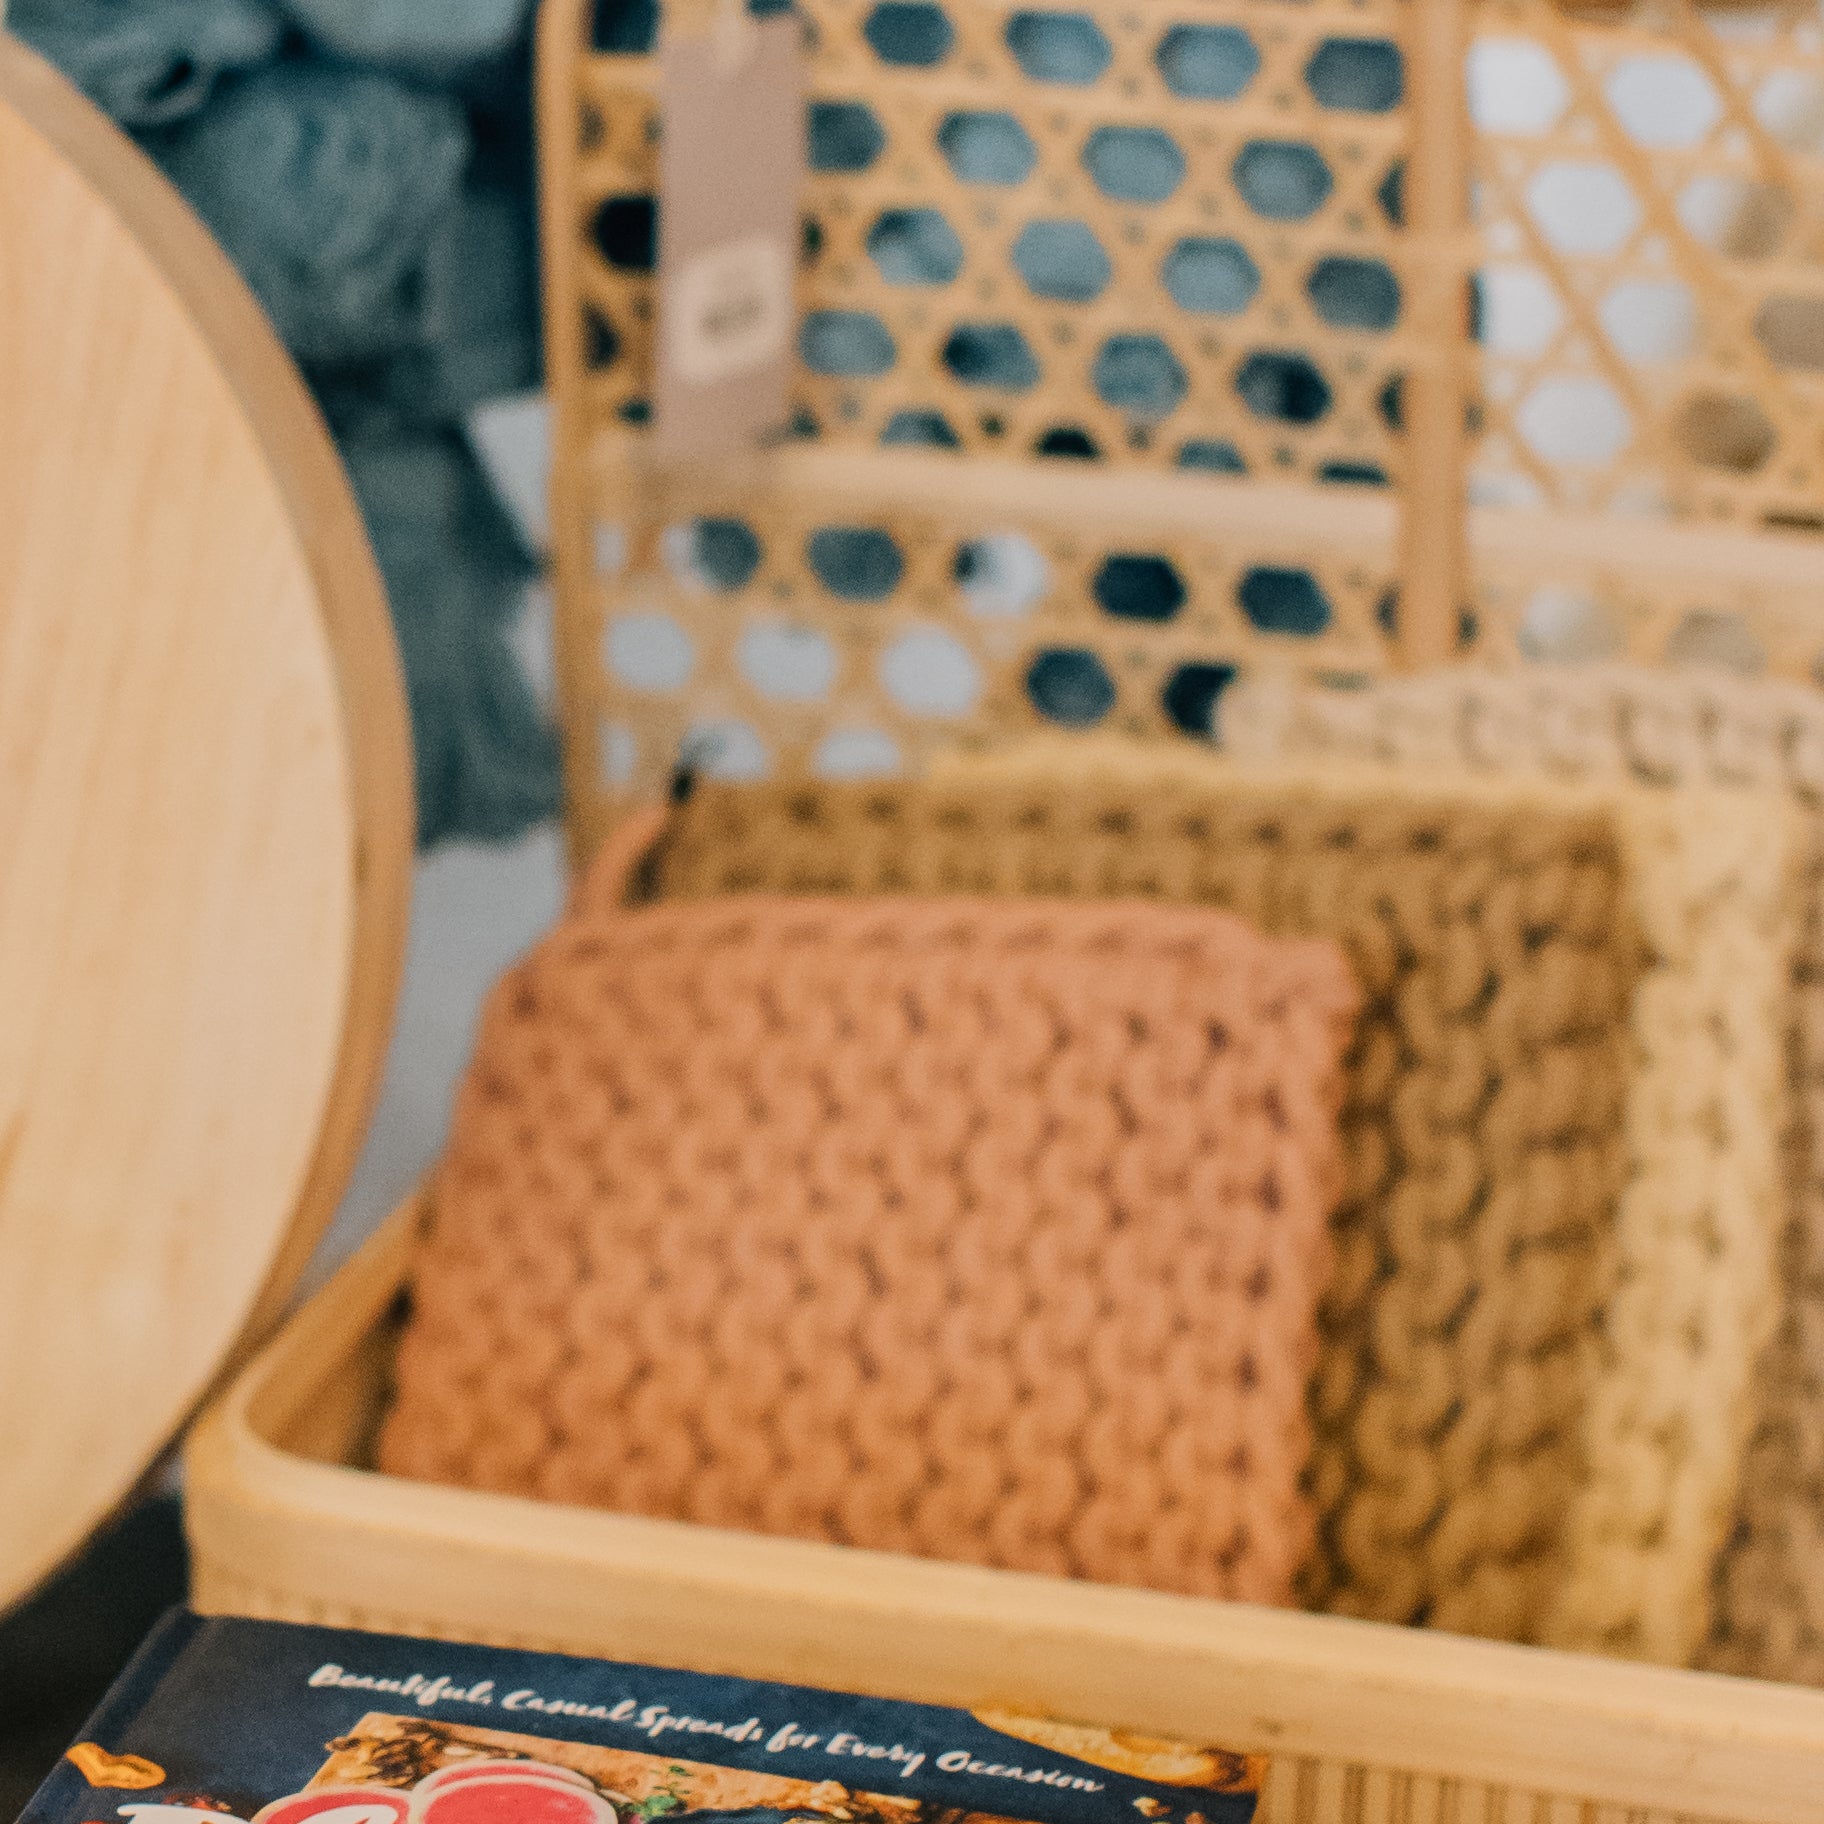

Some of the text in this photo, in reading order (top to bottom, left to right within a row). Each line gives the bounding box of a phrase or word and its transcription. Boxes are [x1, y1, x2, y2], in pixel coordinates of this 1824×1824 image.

[501, 1690, 637, 1722] Casual
[635, 1704, 764, 1743] Spreads
[765, 1723, 820, 1753] for
[824, 1732, 926, 1778] Every
[935, 1751, 1106, 1793] Occasion
